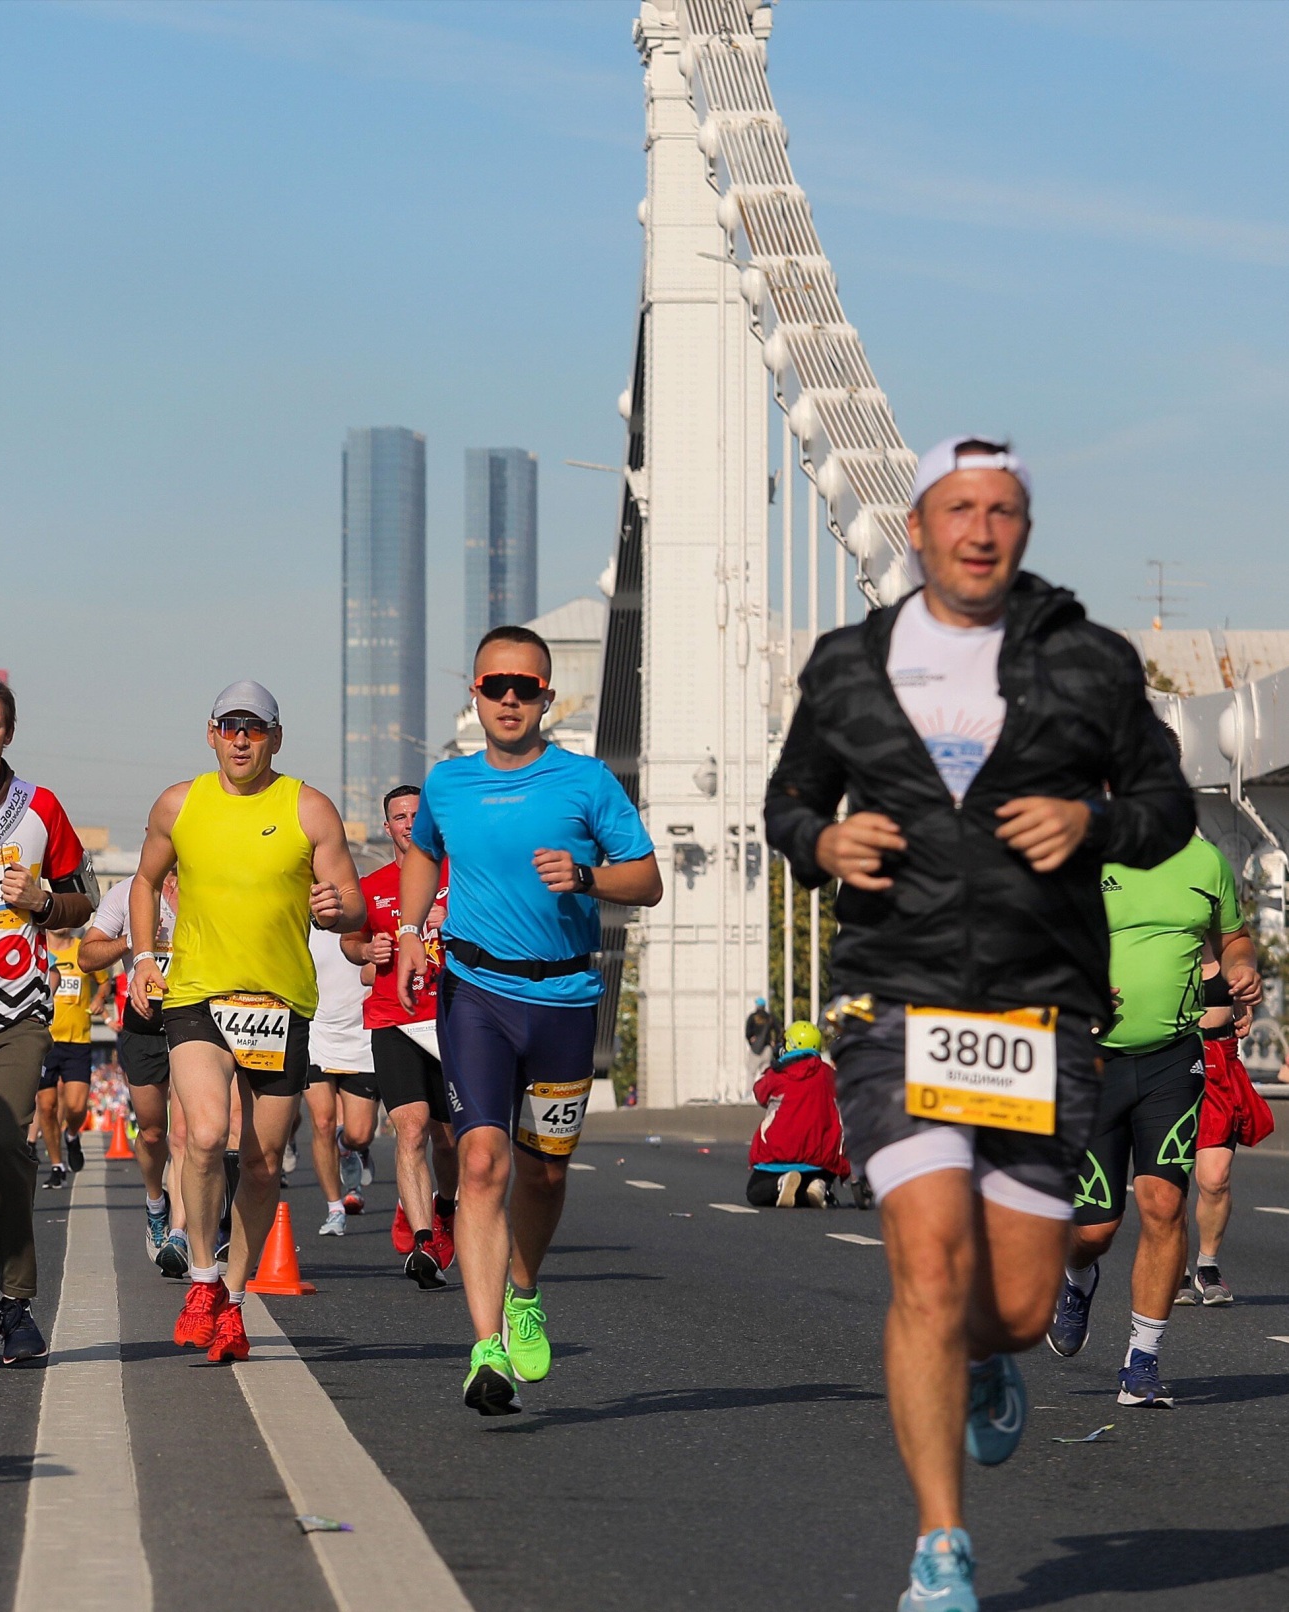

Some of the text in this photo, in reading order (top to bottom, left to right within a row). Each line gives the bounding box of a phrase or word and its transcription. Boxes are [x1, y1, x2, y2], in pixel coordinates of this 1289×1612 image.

[214, 1011, 286, 1039] 14444
[236, 1039, 258, 1047] МАРАТ
[929, 1027, 1034, 1073] 3800
[921, 1087, 939, 1110] D
[548, 1123, 581, 1135] АЛЕКСЕ
